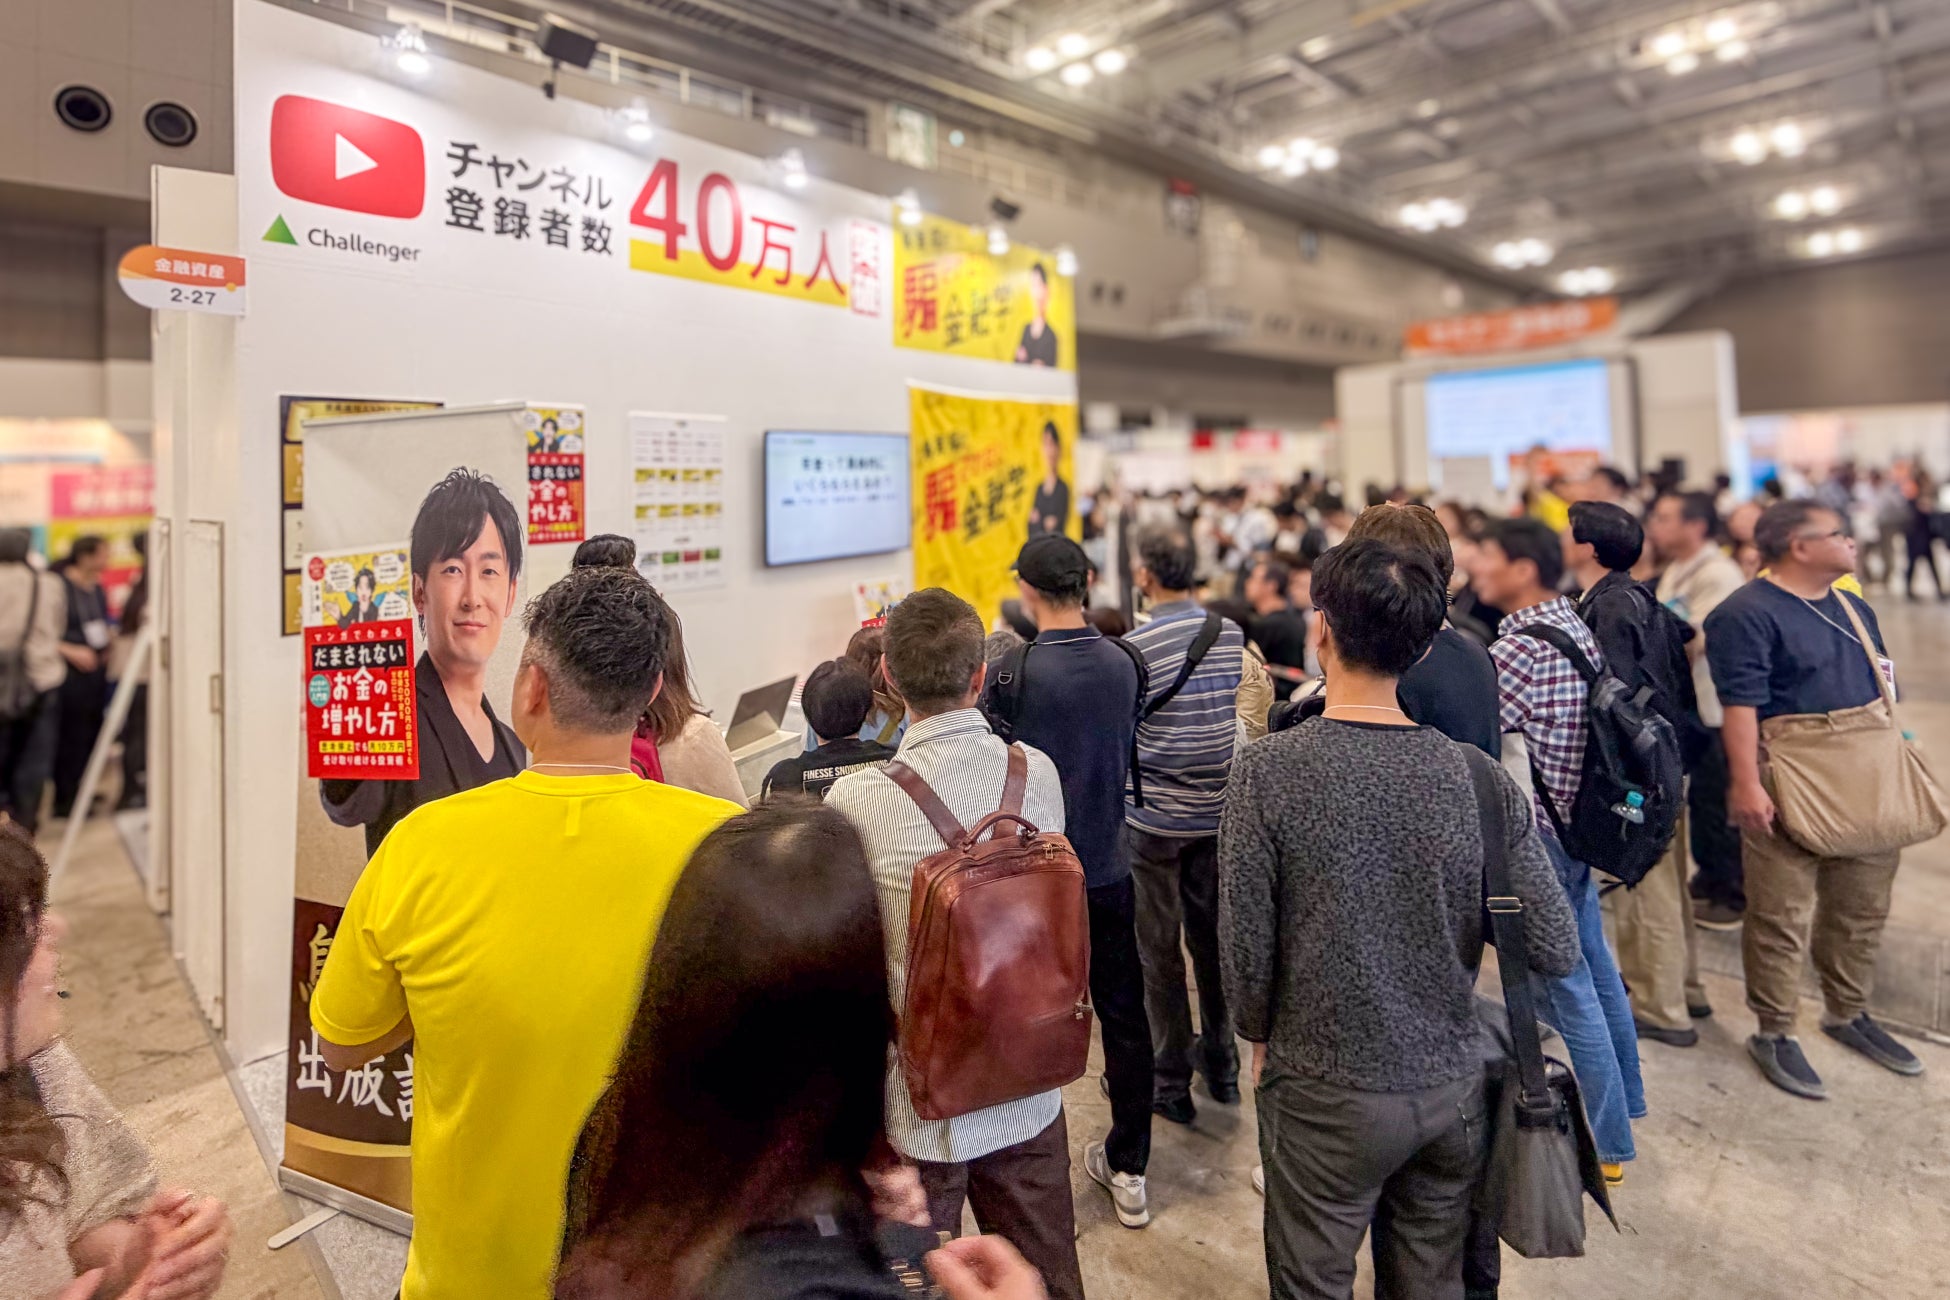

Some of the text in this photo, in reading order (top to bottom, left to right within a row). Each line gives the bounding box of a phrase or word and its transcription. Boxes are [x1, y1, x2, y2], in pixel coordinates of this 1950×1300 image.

[446, 140, 613, 210] チャンネル
[445, 186, 613, 256] 登録者数
[629, 157, 847, 297] 40万人
[307, 228, 422, 262] Challenger
[154, 257, 225, 280] 金融資産
[170, 287, 217, 306] 2-27
[314, 626, 403, 642] マンガでわかる
[314, 643, 405, 668] だまされない
[332, 665, 388, 701] お金の
[321, 702, 398, 736] 増やし方
[803, 767, 834, 780] FINESSE
